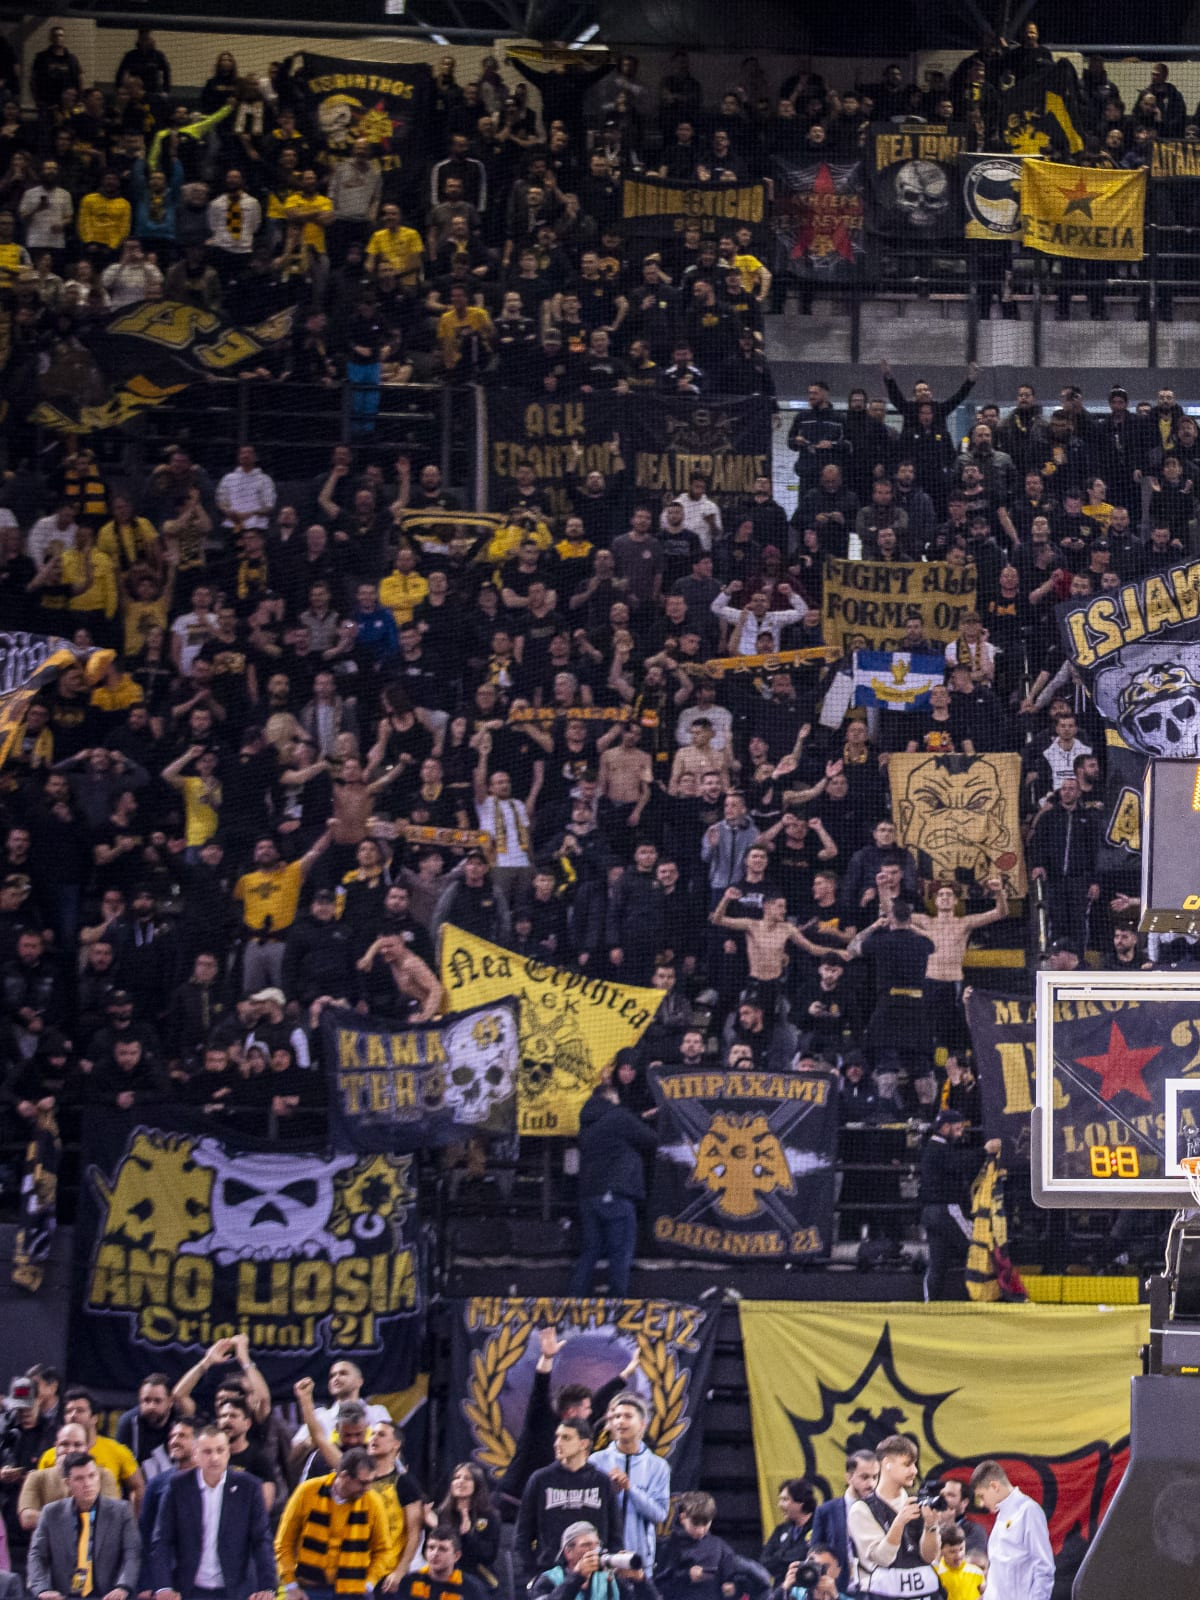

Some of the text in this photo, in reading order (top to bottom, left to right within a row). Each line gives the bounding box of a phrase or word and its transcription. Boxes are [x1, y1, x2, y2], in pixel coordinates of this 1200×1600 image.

[826, 559, 914, 594] FIGHT
[827, 592, 922, 629] FORMS
[449, 948, 512, 989] Nea
[338, 1028, 447, 1068] KAMA
[522, 1110, 559, 1130] lub
[90, 1244, 215, 1313] ANO
[139, 1305, 377, 1347] Original 21
[900, 1571, 924, 1592] HB
